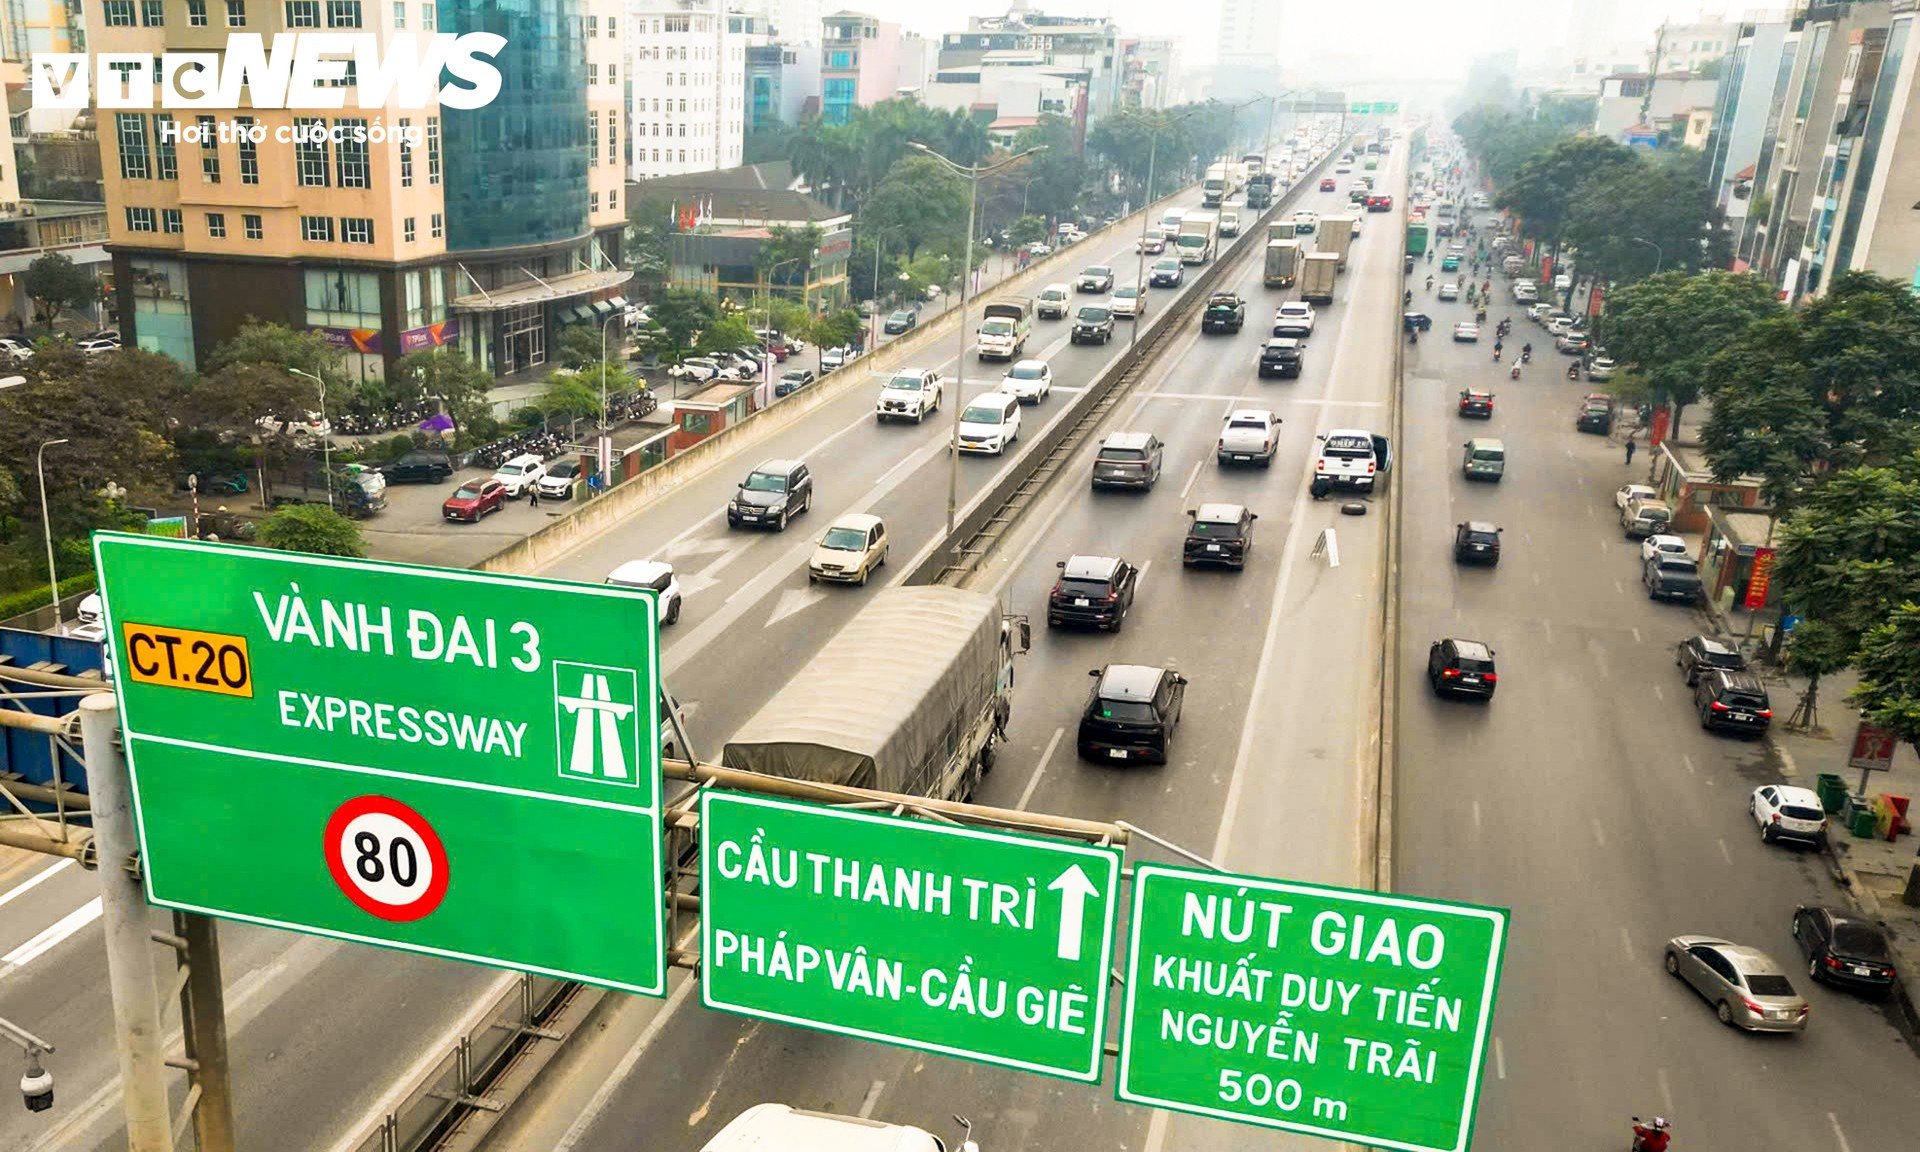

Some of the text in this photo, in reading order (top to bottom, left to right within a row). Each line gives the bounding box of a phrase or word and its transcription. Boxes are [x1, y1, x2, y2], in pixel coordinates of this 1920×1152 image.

[129, 631, 247, 690] CT.20
[254, 581, 542, 673] VÀNH ĐAI 3
[279, 690, 528, 758] EXPRESSWAY
[354, 831, 418, 888] 80
[717, 827, 1036, 930] CẦU THANH TRÌ
[714, 930, 822, 984] PHÁP
[1183, 887, 1445, 971] NÚT GIAO
[1153, 953, 1462, 1033] KHUẤT DUY TIẾN
[1161, 1009, 1437, 1085] NGUYỄN TRÃI
[1219, 1069, 1347, 1121] 500 m
